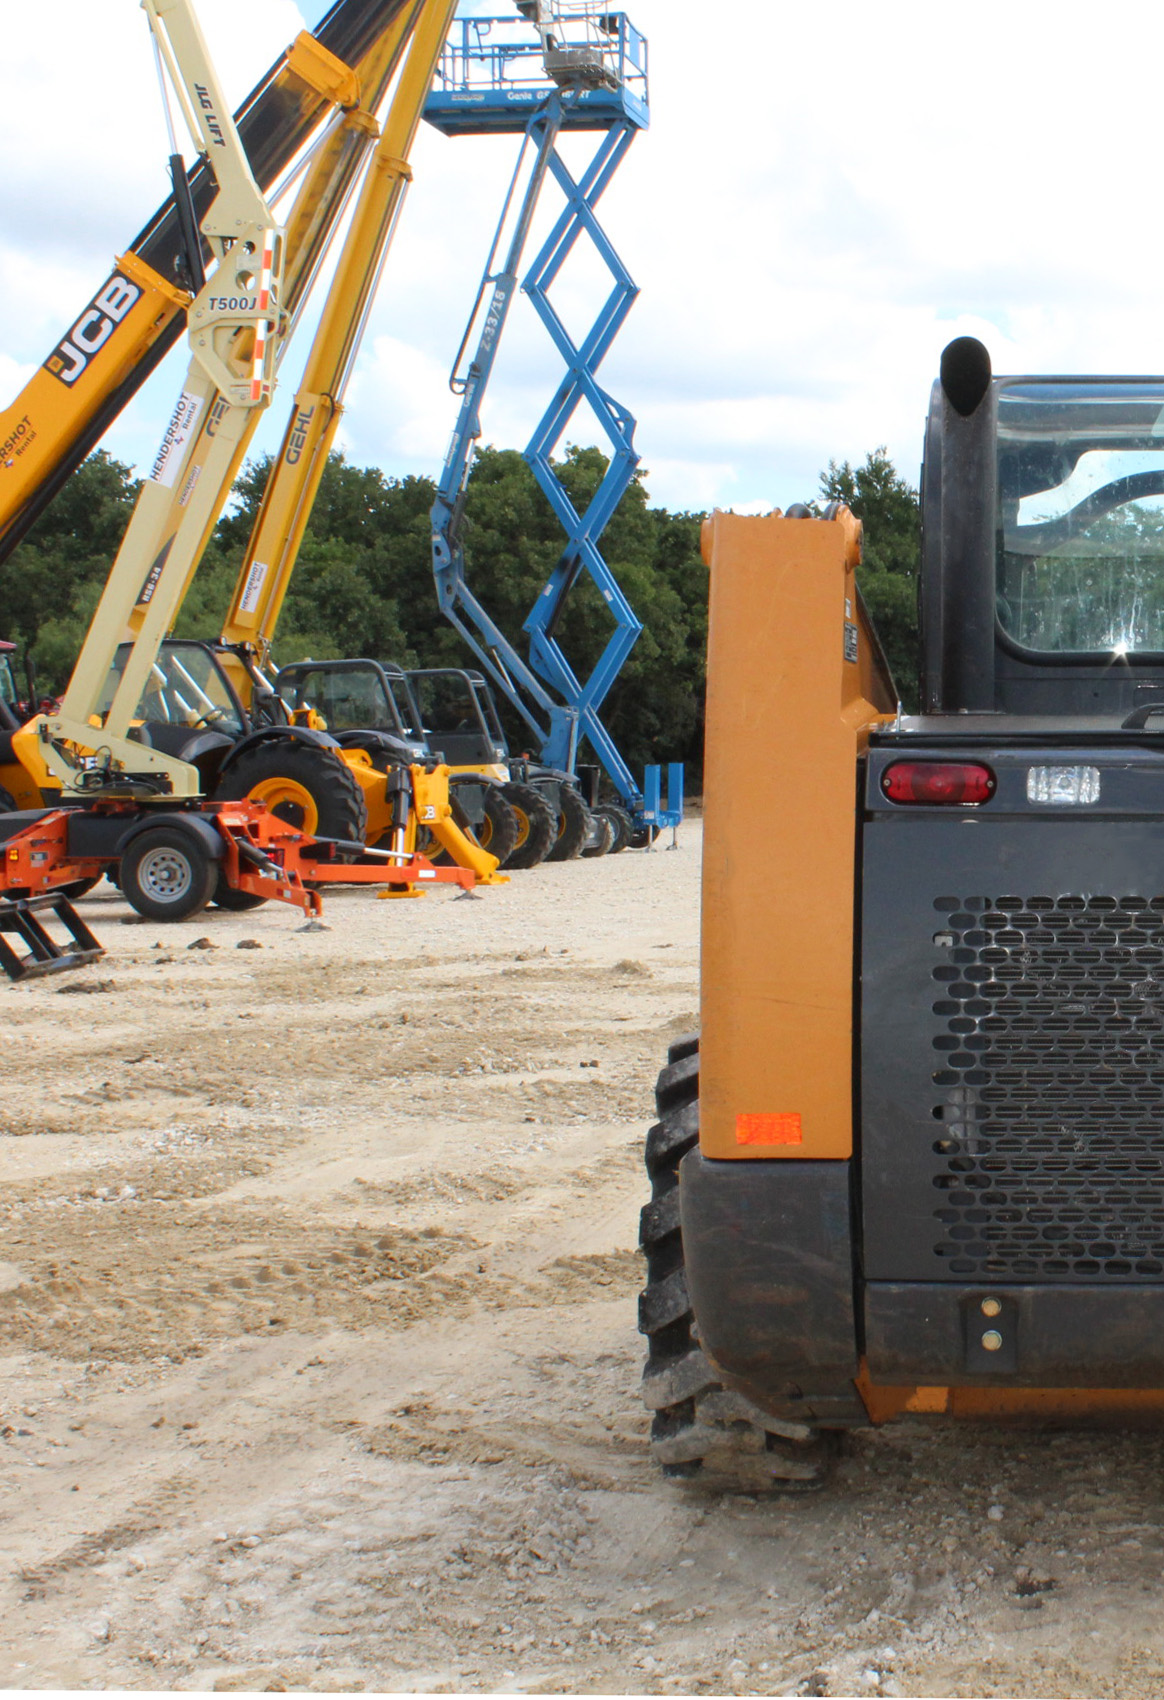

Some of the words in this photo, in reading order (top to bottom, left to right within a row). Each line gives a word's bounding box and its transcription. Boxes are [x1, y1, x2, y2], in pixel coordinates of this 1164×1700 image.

[194, 83, 213, 109] JLG
[205, 114, 226, 147] LIFT
[60, 276, 139, 382] JCB
[209, 297, 257, 311] T500J
[0, 414, 31, 464] RSHOT
[150, 392, 190, 481] HENDERSHOT
[182, 402, 198, 430] Rental
[285, 405, 315, 465] GEHL
[15, 430, 37, 457] Rental
[241, 562, 259, 609] HENDERSHOT
